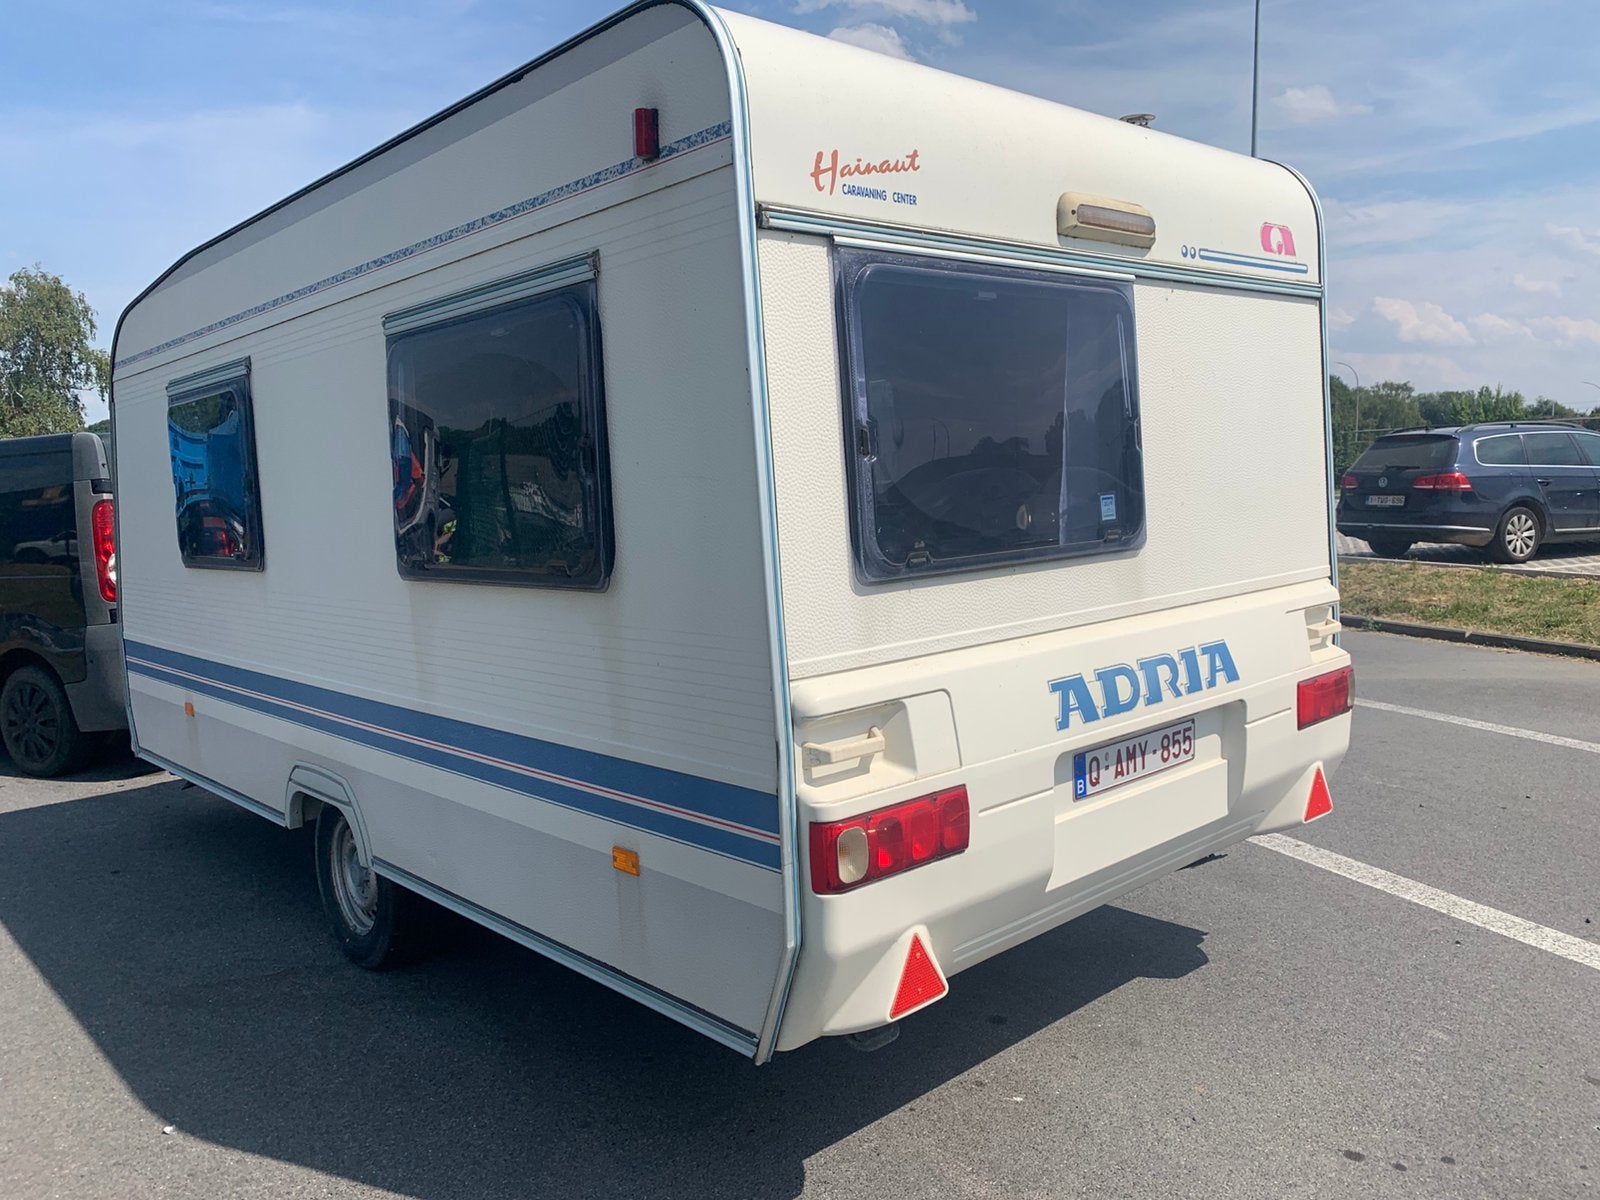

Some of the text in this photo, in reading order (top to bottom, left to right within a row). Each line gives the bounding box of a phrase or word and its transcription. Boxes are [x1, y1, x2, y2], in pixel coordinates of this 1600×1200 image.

[810, 149, 921, 196] Hainaut
[842, 183, 918, 206] CARAVANING CENTER
[1048, 639, 1241, 732] ADRIA
[1076, 778, 1085, 795] B
